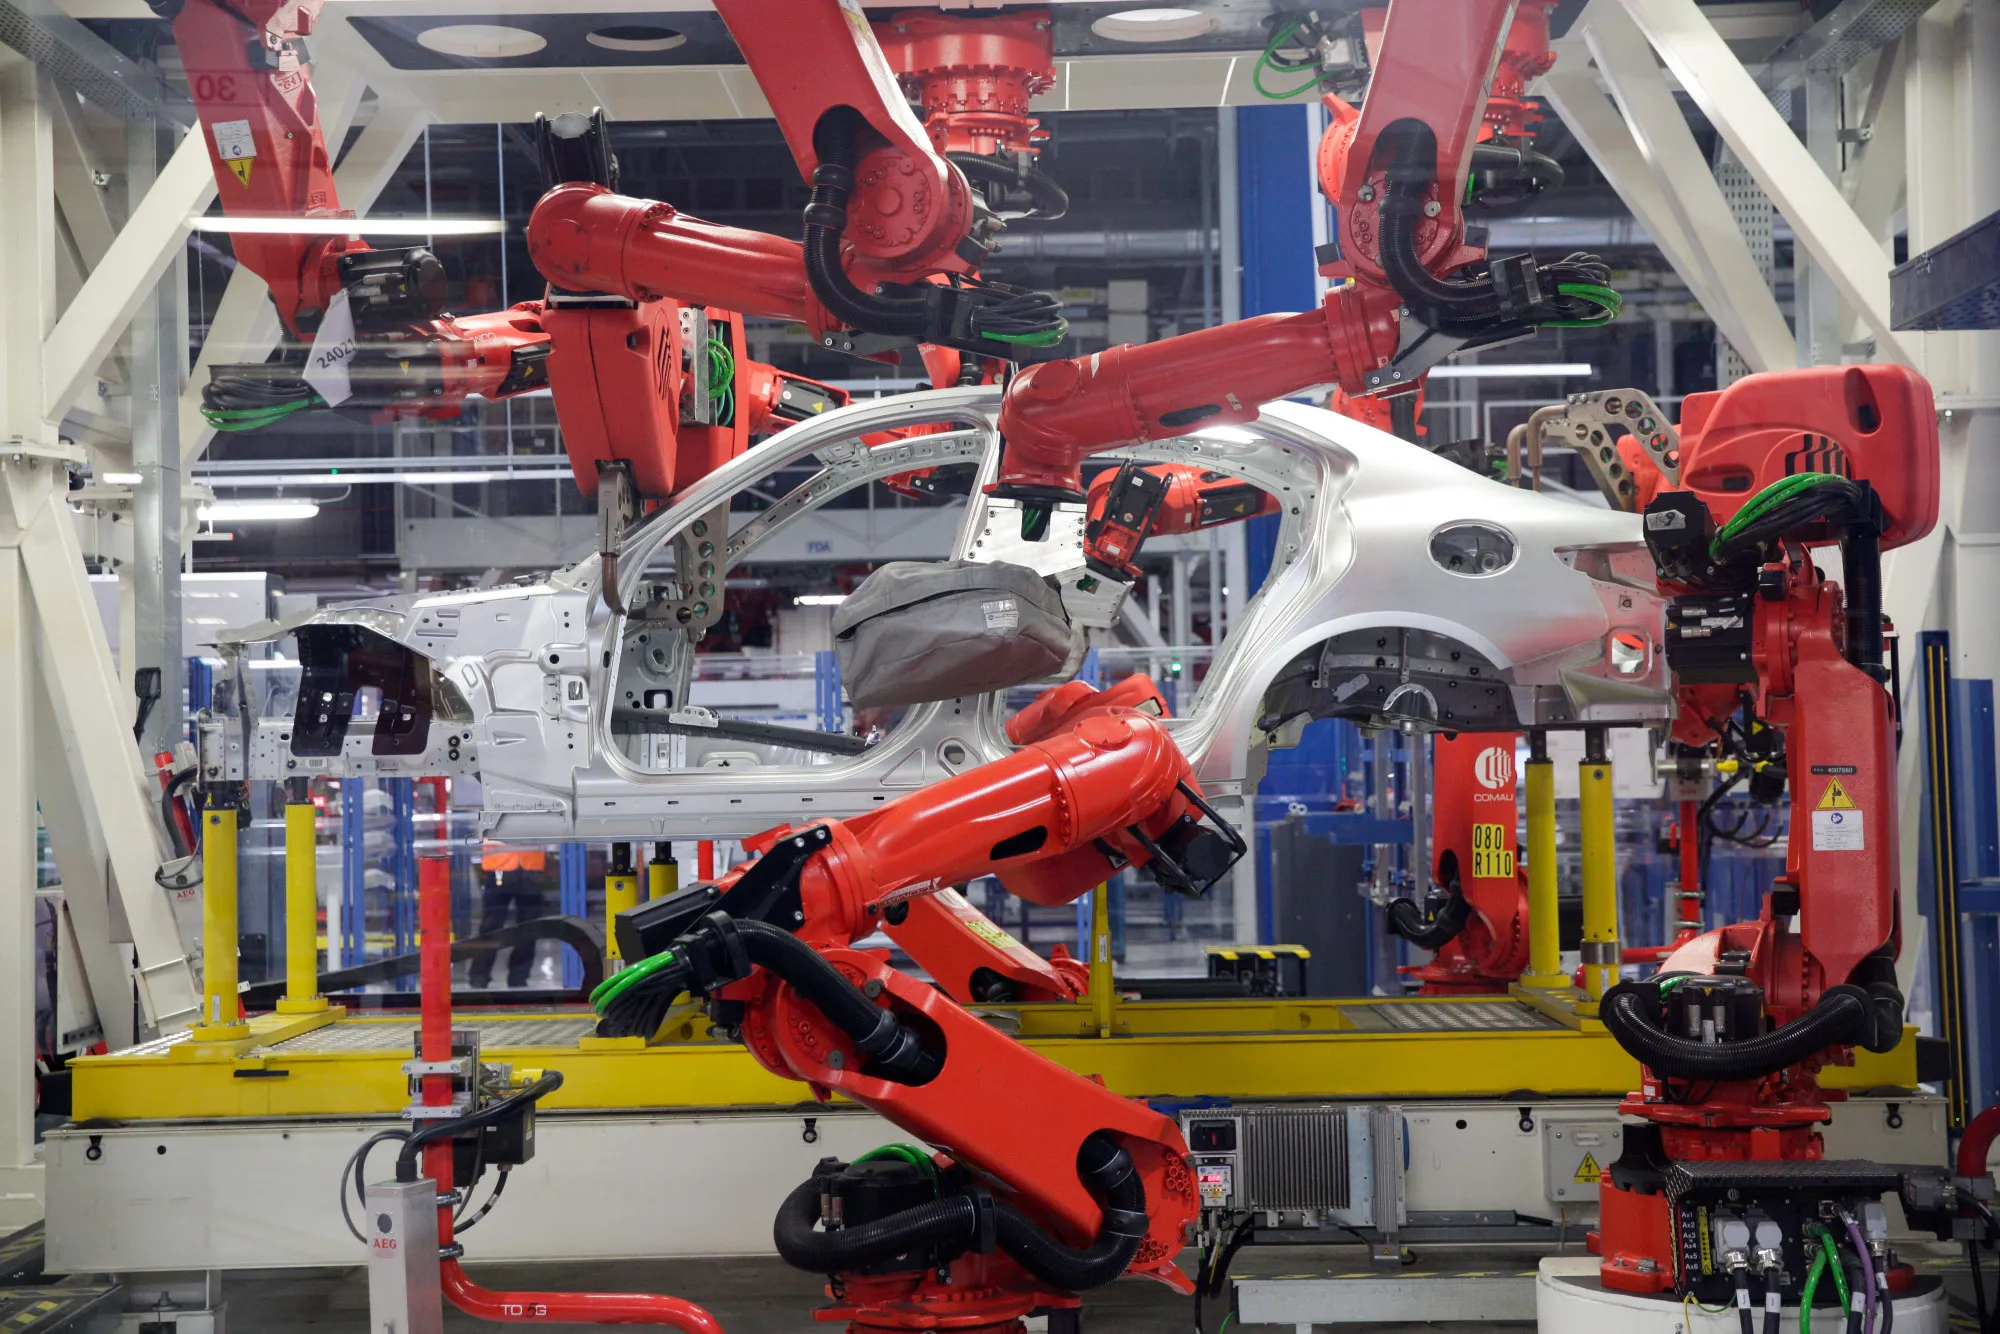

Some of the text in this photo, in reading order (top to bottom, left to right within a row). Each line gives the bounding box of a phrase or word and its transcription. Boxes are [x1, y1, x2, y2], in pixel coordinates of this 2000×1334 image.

[1473, 793, 1514, 802] COMAU
[1474, 825, 1503, 850] 080
[1474, 852, 1512, 876] R110
[373, 1238, 397, 1250] AEG
